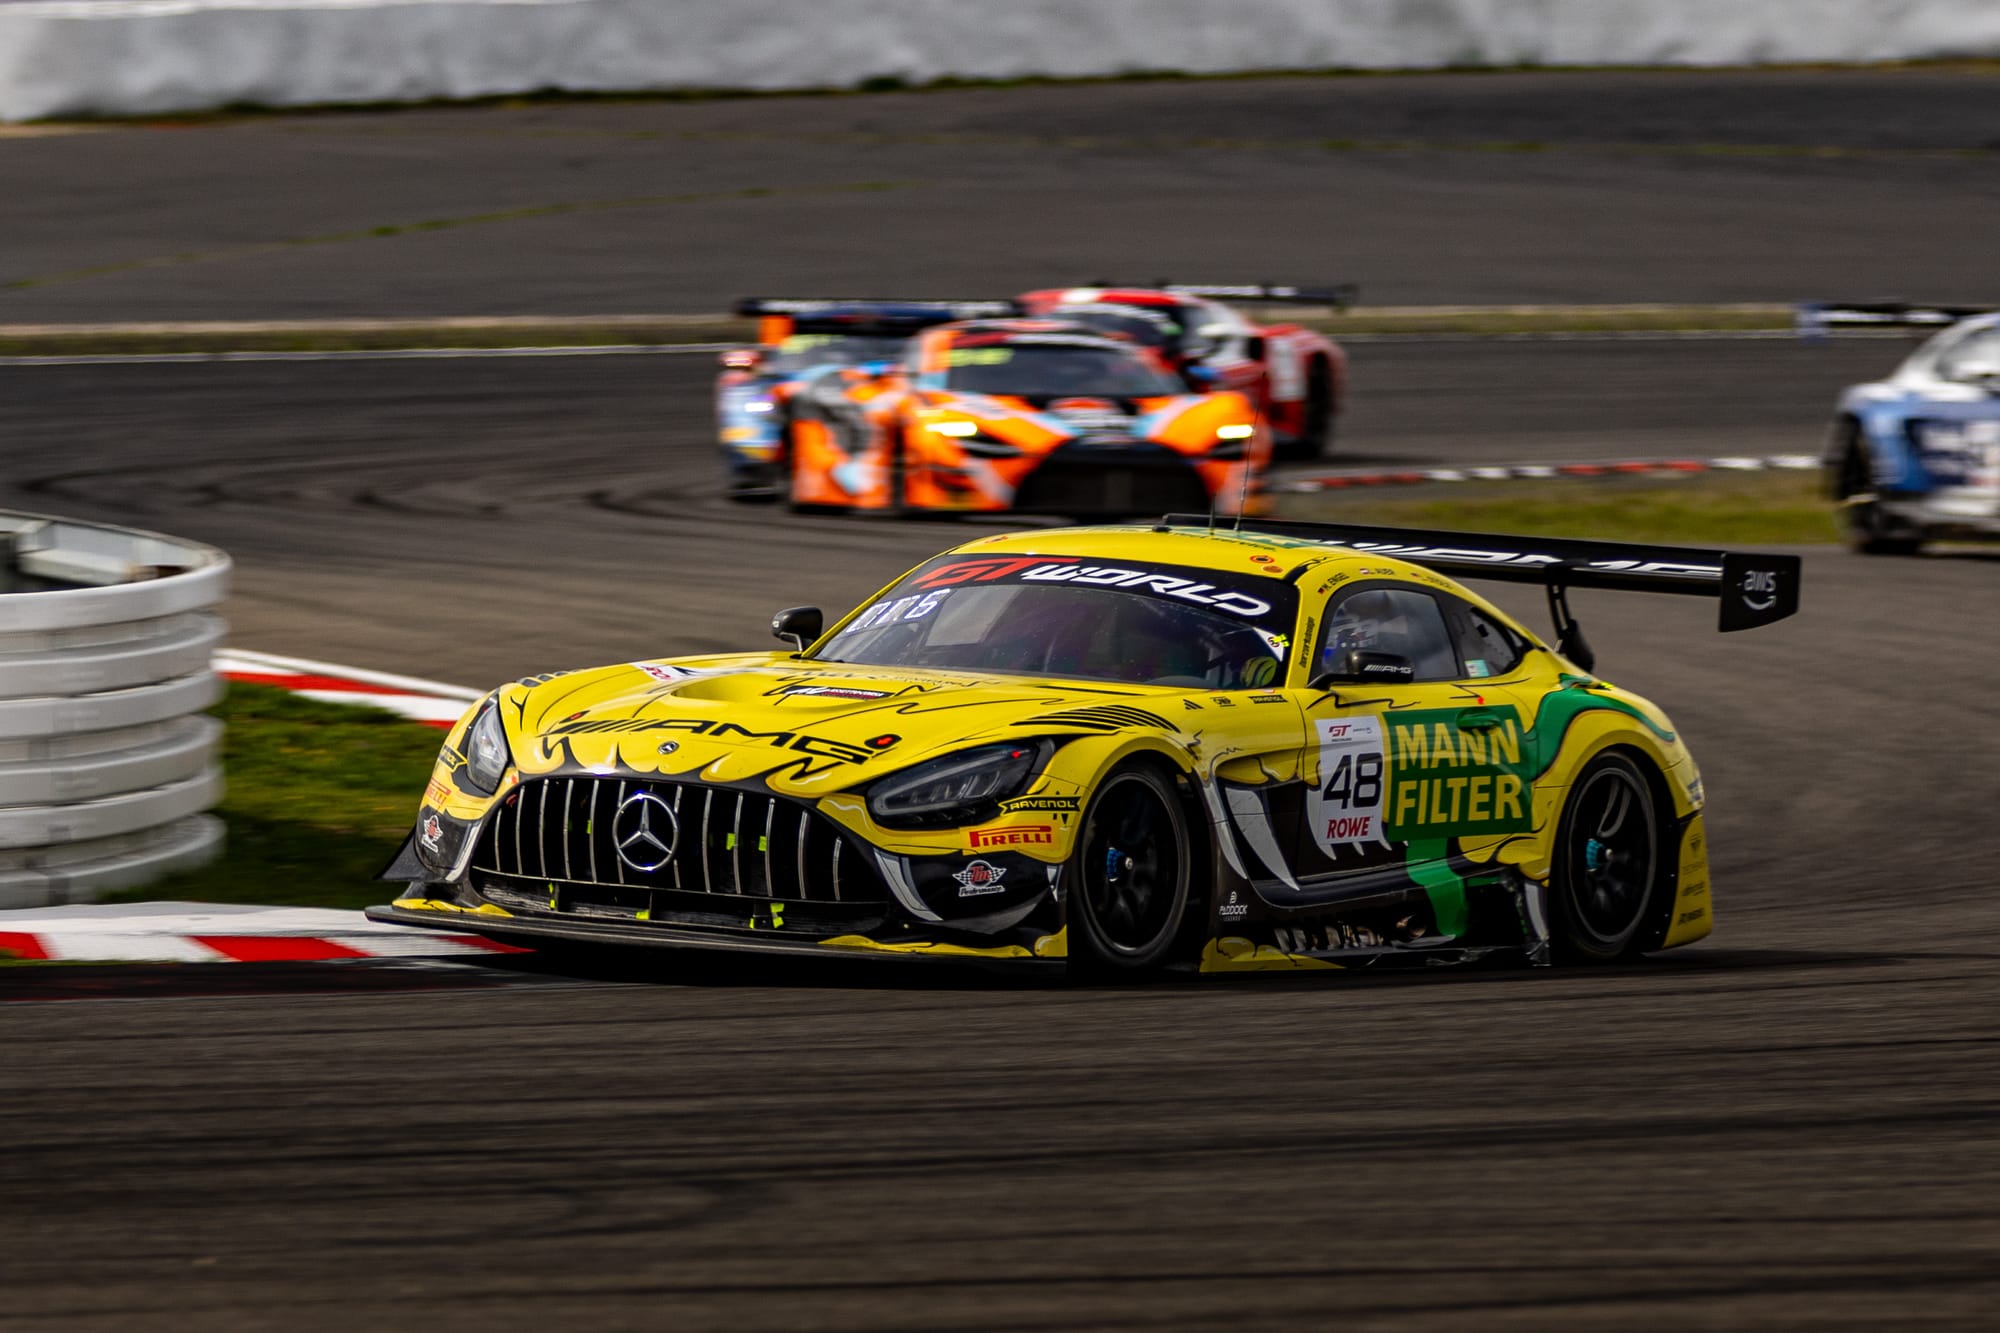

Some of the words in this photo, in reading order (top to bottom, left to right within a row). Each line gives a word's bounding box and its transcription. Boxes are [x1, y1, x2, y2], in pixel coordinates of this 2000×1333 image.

[911, 557, 1082, 590] GT
[1020, 564, 1271, 616] WORLD
[632, 719, 875, 765] AMG
[1329, 724, 1352, 737] GT
[1395, 719, 1520, 770] MANN
[1322, 752, 1383, 810] 48
[1009, 799, 1076, 811] RAVENOL
[1396, 774, 1523, 826] FILTER
[969, 826, 1052, 848] PIRELLI
[1326, 816, 1371, 839] ROWE
[1219, 904, 1248, 915] PADDOCK
